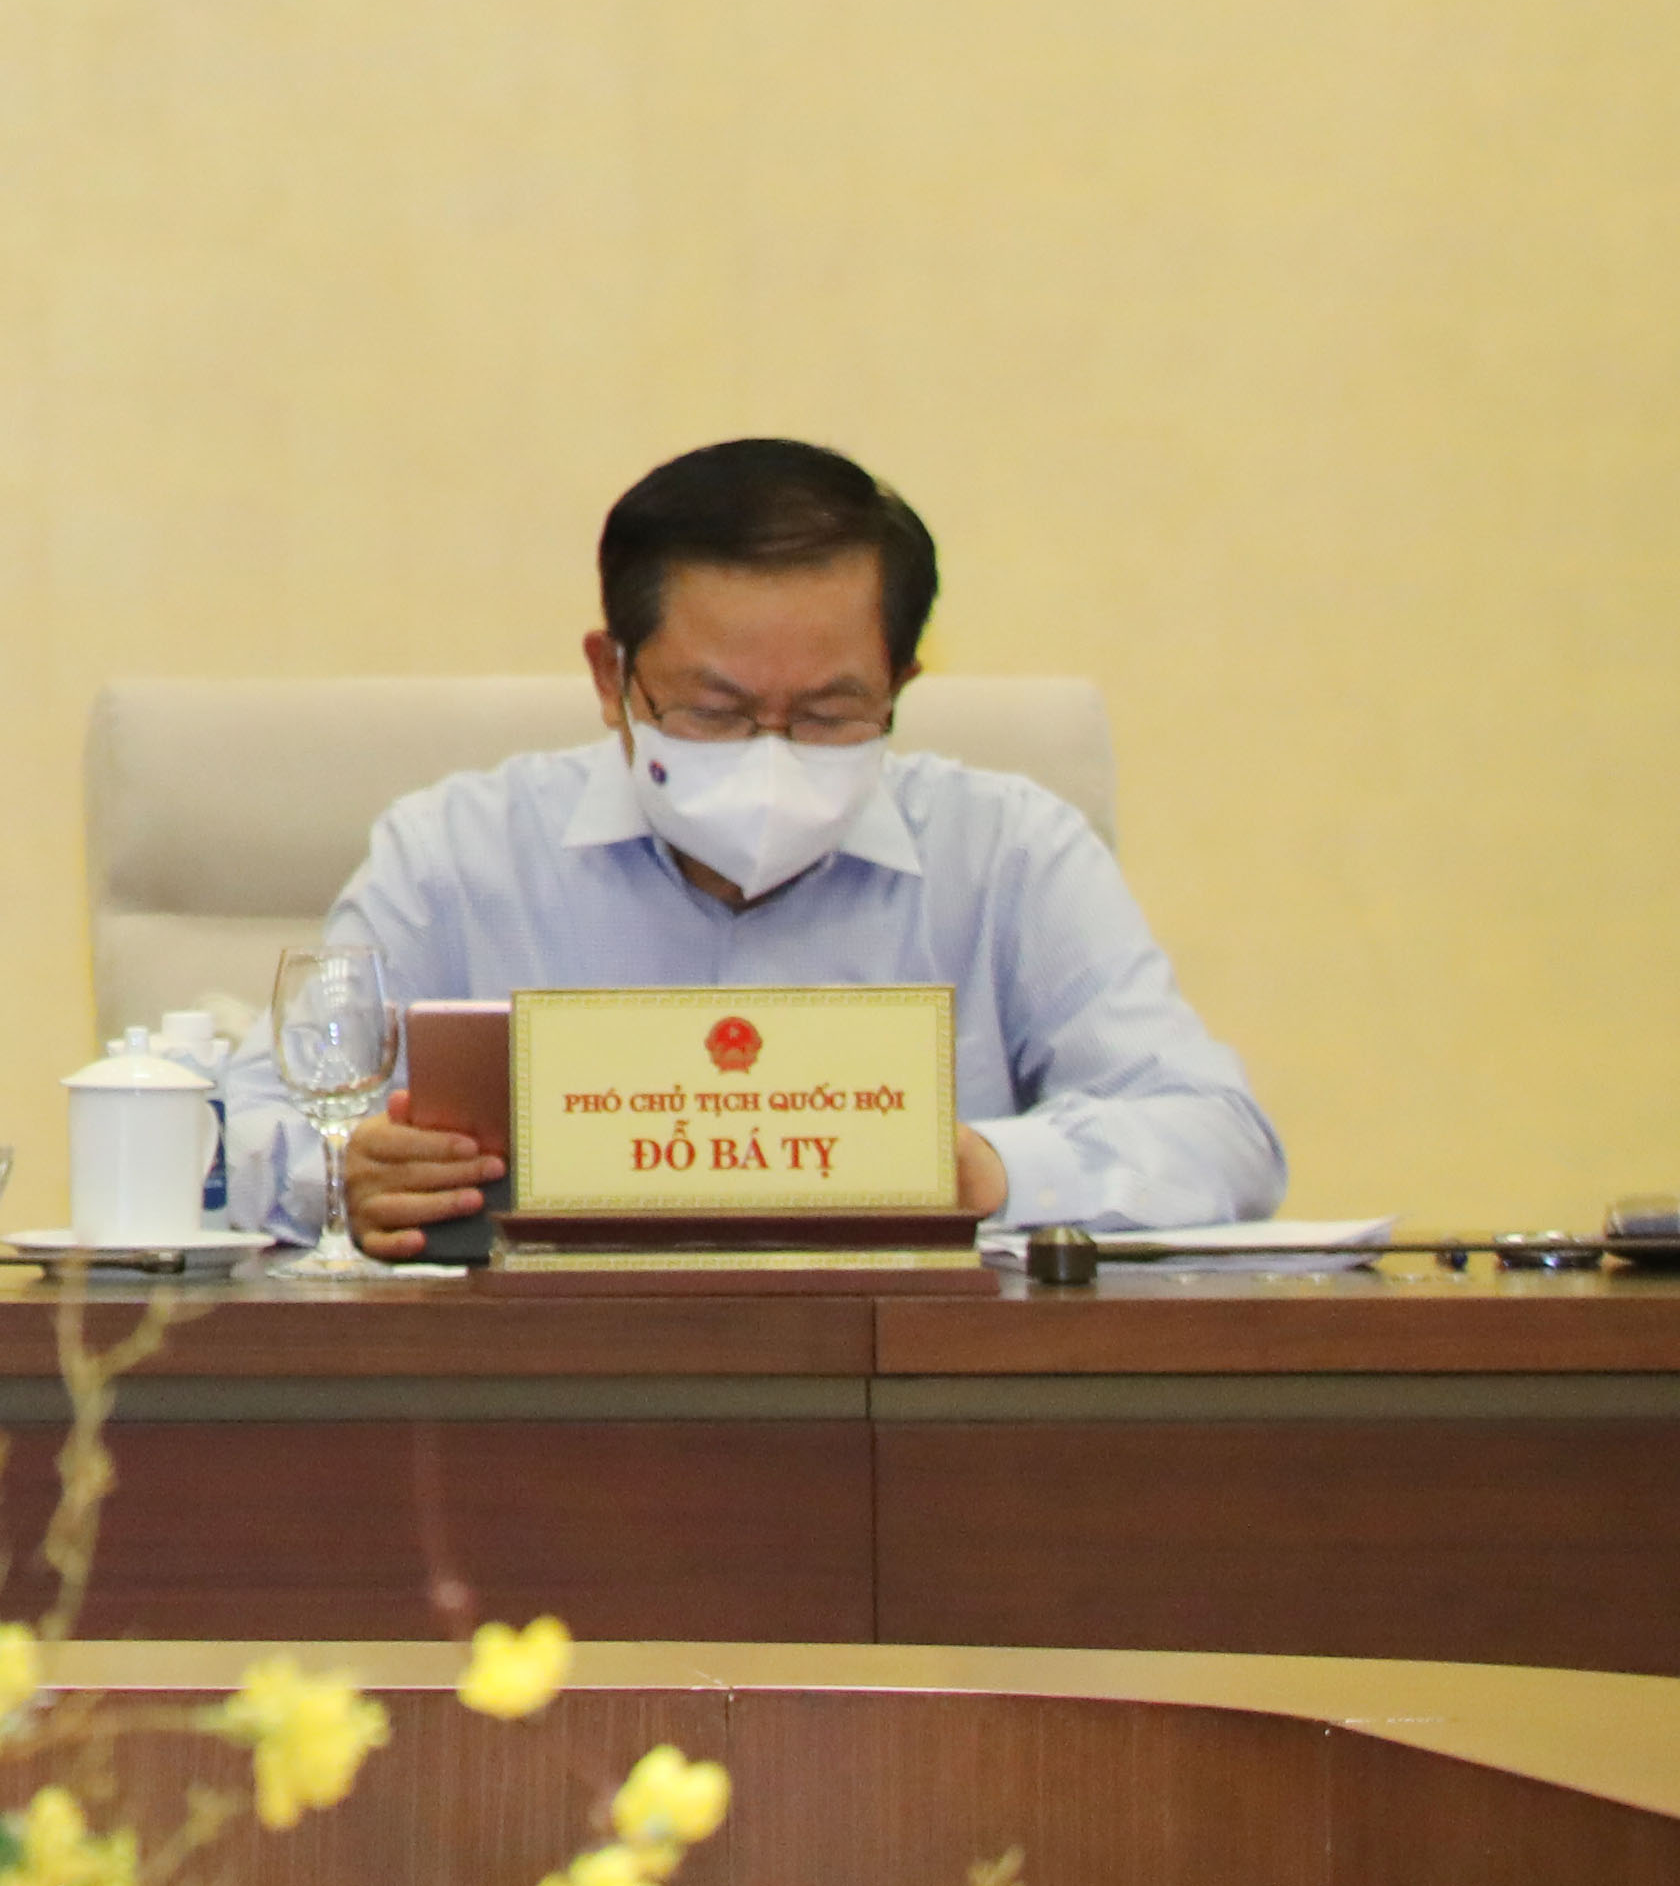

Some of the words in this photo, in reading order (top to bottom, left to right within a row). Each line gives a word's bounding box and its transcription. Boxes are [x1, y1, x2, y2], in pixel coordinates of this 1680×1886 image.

[563, 1087, 622, 1113] PHÓ
[629, 1085, 686, 1113] CHỦ
[694, 1092, 761, 1118] TỊCH
[768, 1082, 846, 1112] QUỐC
[854, 1085, 905, 1116] HỘI
[631, 1119, 696, 1172] ĐỖ
[709, 1126, 770, 1171] BÁ
[780, 1135, 839, 1179] TỴ
